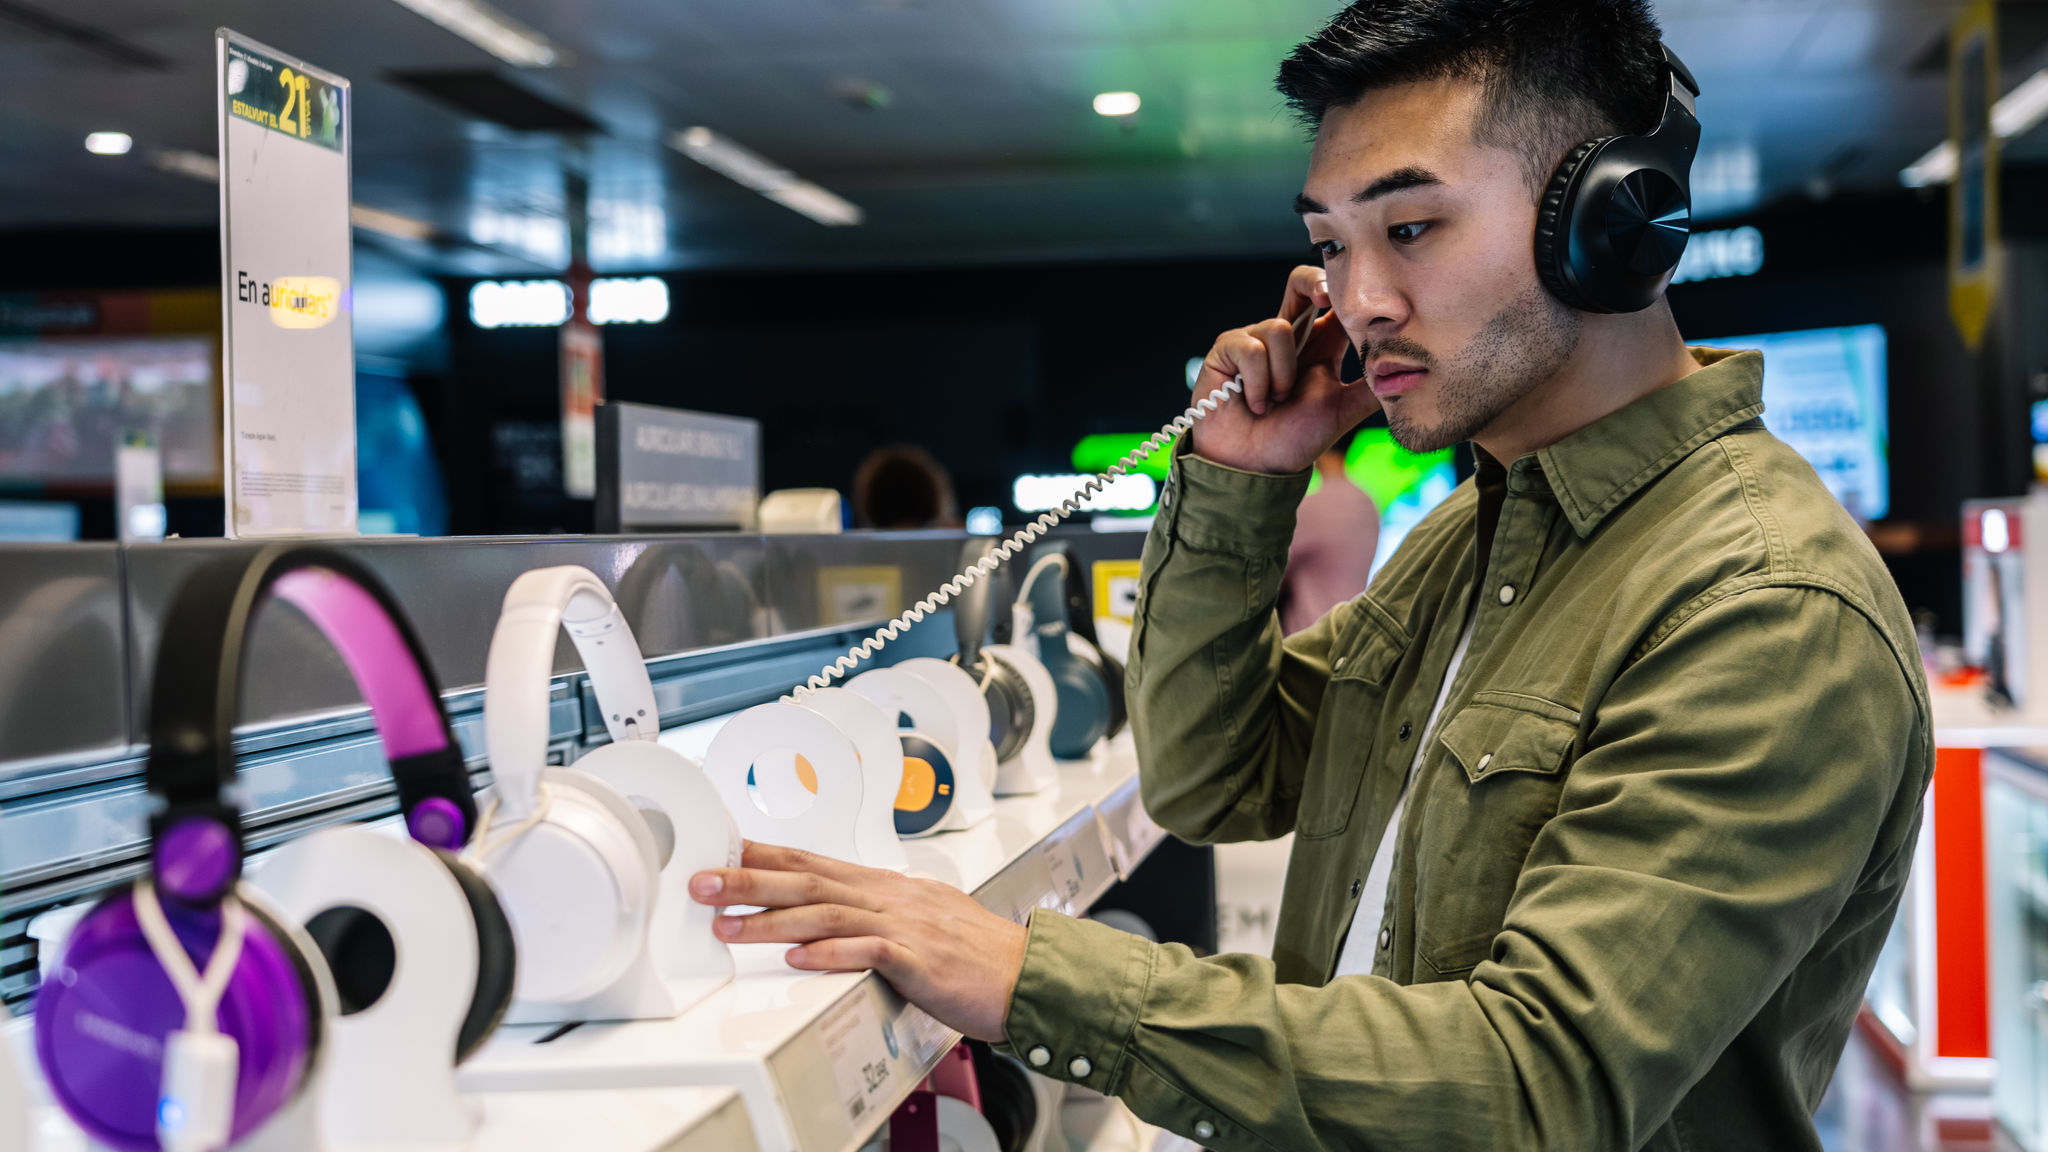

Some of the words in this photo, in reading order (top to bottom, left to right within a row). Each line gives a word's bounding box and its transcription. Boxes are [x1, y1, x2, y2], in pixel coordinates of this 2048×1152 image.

[269, 113, 279, 128] EL
[279, 67, 307, 139] 21
[238, 270, 258, 304] En
